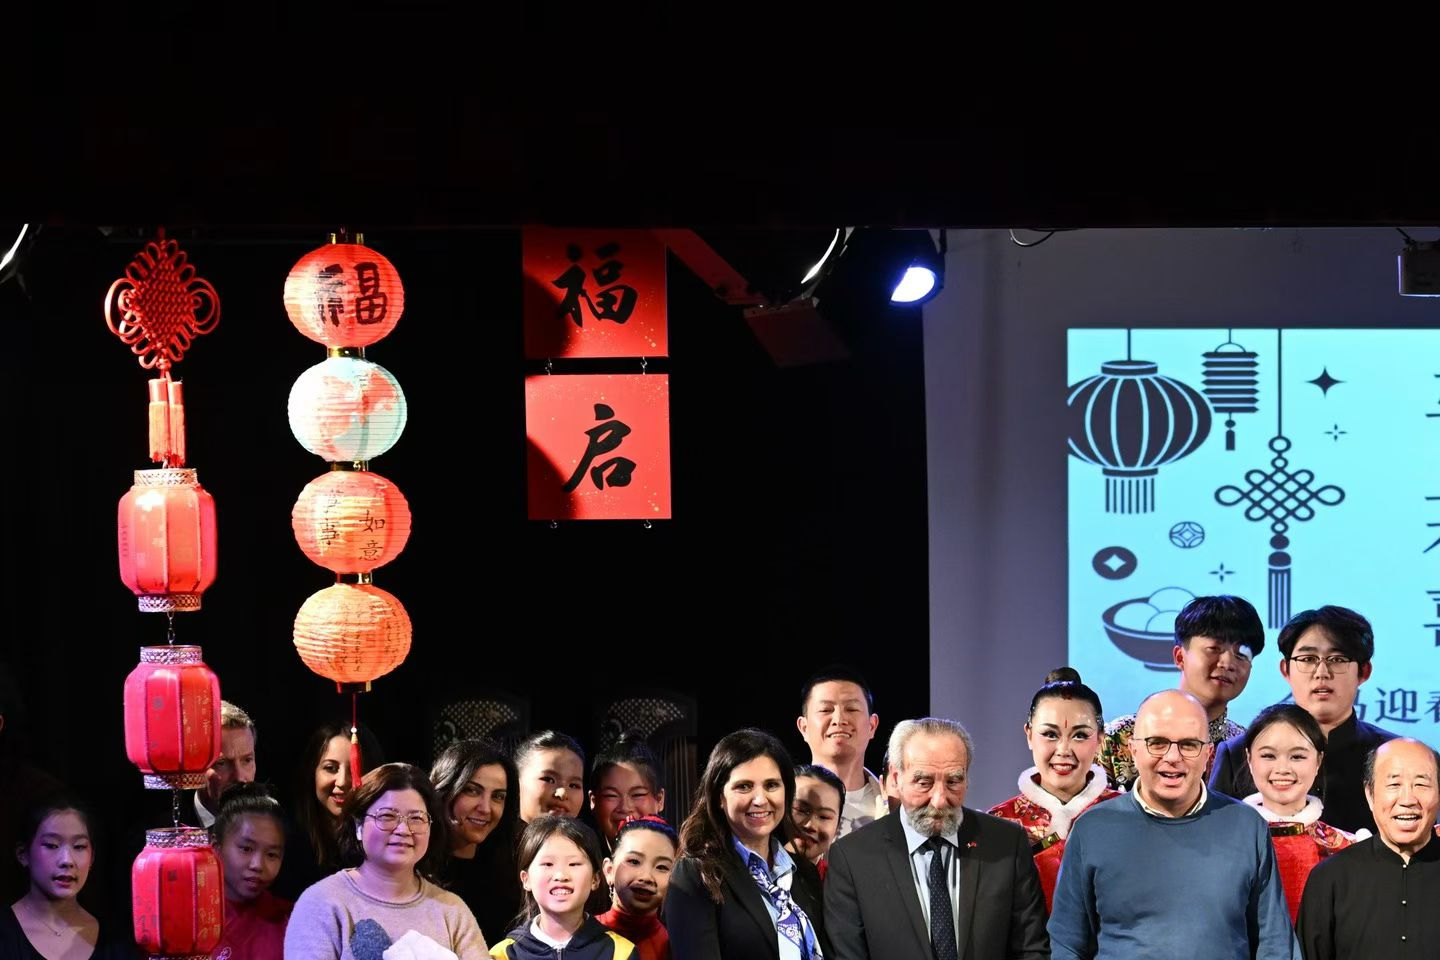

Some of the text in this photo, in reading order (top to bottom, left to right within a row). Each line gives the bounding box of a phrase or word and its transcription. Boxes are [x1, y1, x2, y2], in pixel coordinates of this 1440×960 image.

[314, 261, 387, 328] 福
[551, 242, 639, 492] 福 启
[358, 509, 386, 561] 如意
